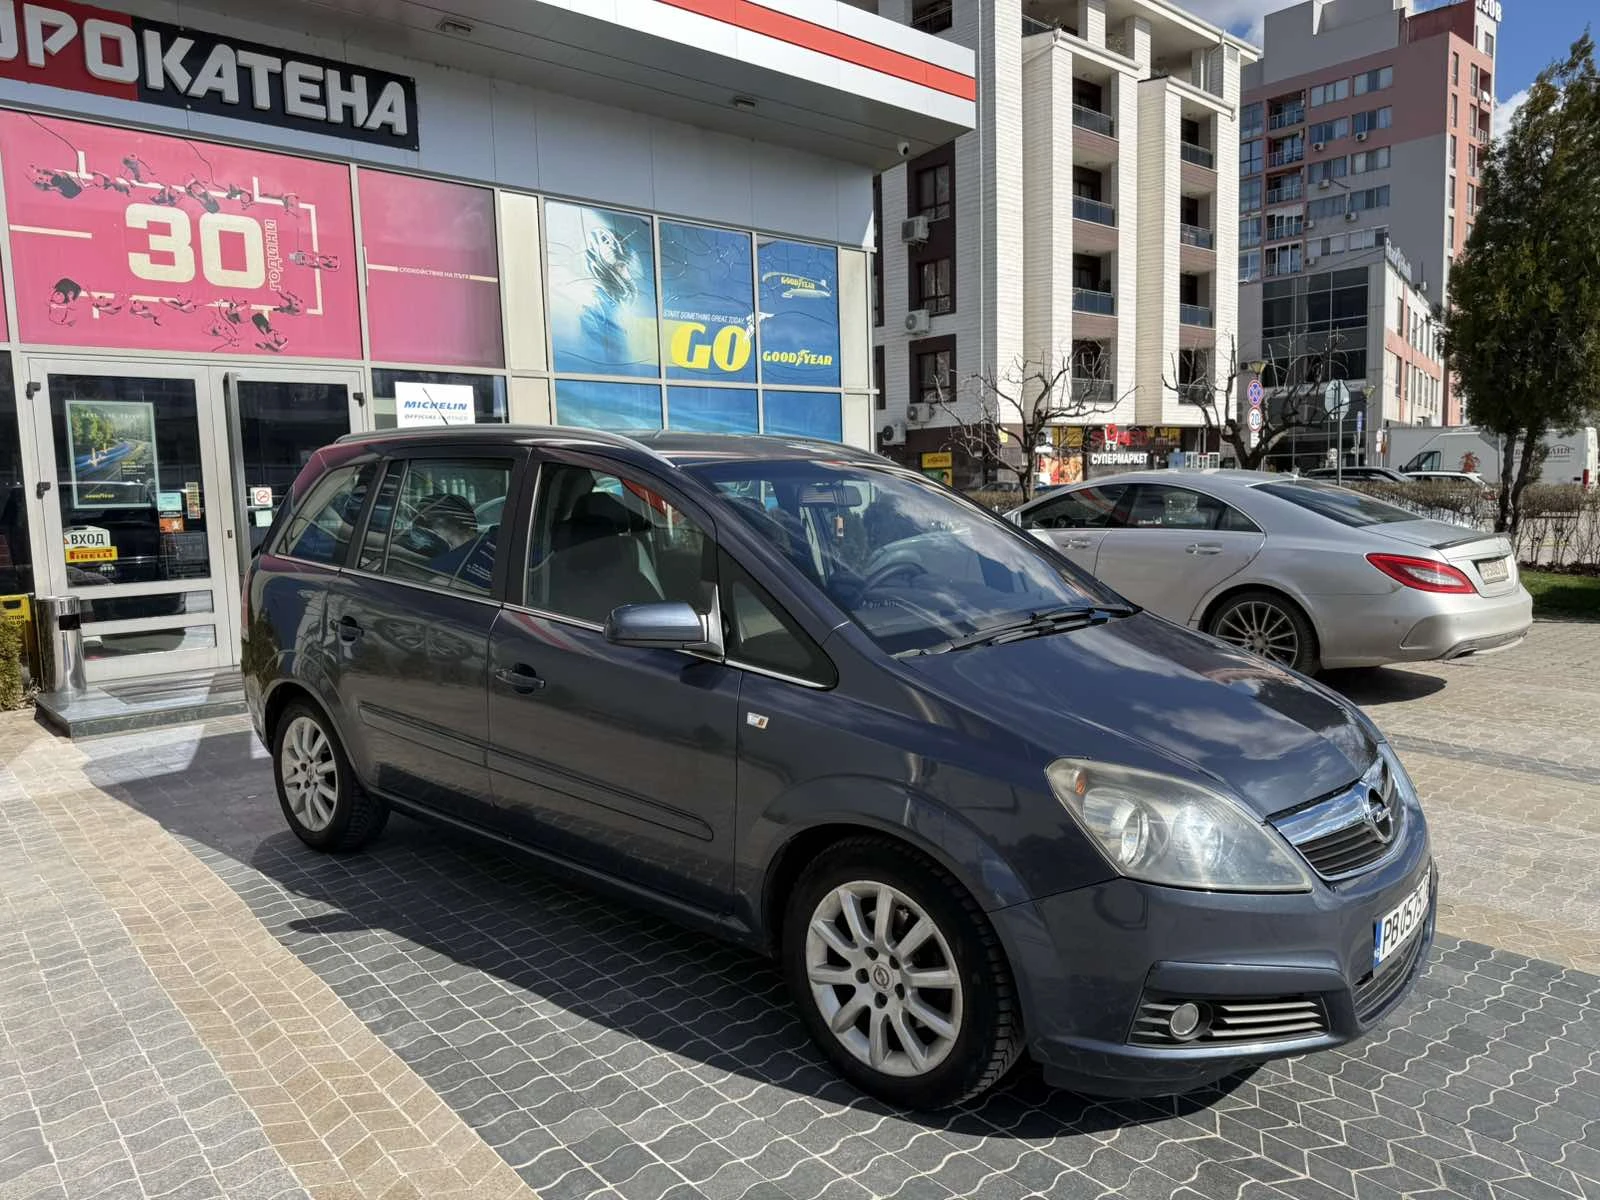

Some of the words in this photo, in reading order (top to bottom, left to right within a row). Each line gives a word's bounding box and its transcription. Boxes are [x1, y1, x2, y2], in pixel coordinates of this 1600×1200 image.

[125, 203, 266, 289] 30
[265, 219, 284, 291] ГОДИНИ
[671, 321, 751, 372] GO
[762, 350, 832, 366] GOODYEAR
[404, 400, 468, 410] MICHELIN
[1091, 453, 1149, 464] СУПЕРМАРКЕТ
[71, 533, 105, 546] ВХОД
